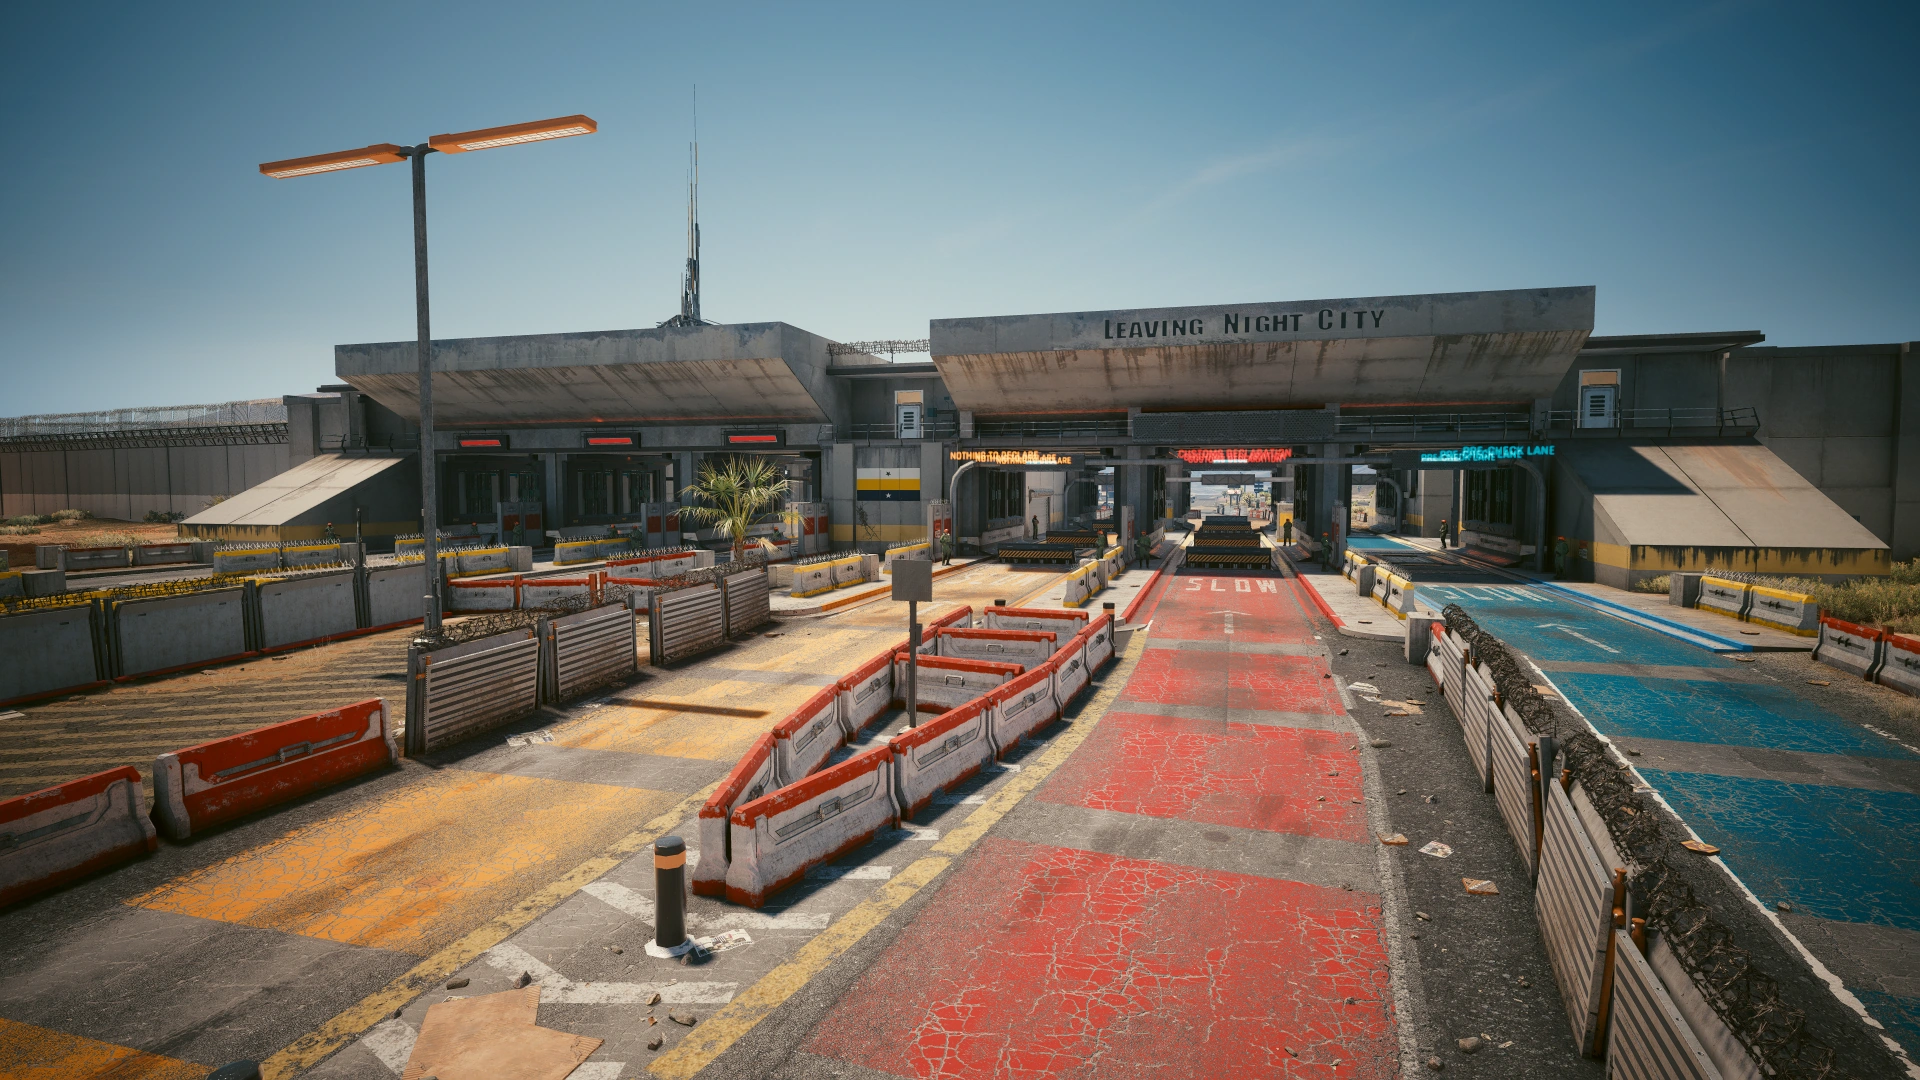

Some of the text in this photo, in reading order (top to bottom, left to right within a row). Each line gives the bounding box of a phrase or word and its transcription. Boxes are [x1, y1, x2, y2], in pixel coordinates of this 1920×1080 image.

[1104, 309, 1385, 339] LEAVING NIGHT CITY
[950, 451, 986, 460] NOTHING
[1527, 446, 1556, 456] LANE
[1186, 578, 1277, 593] SLOW
